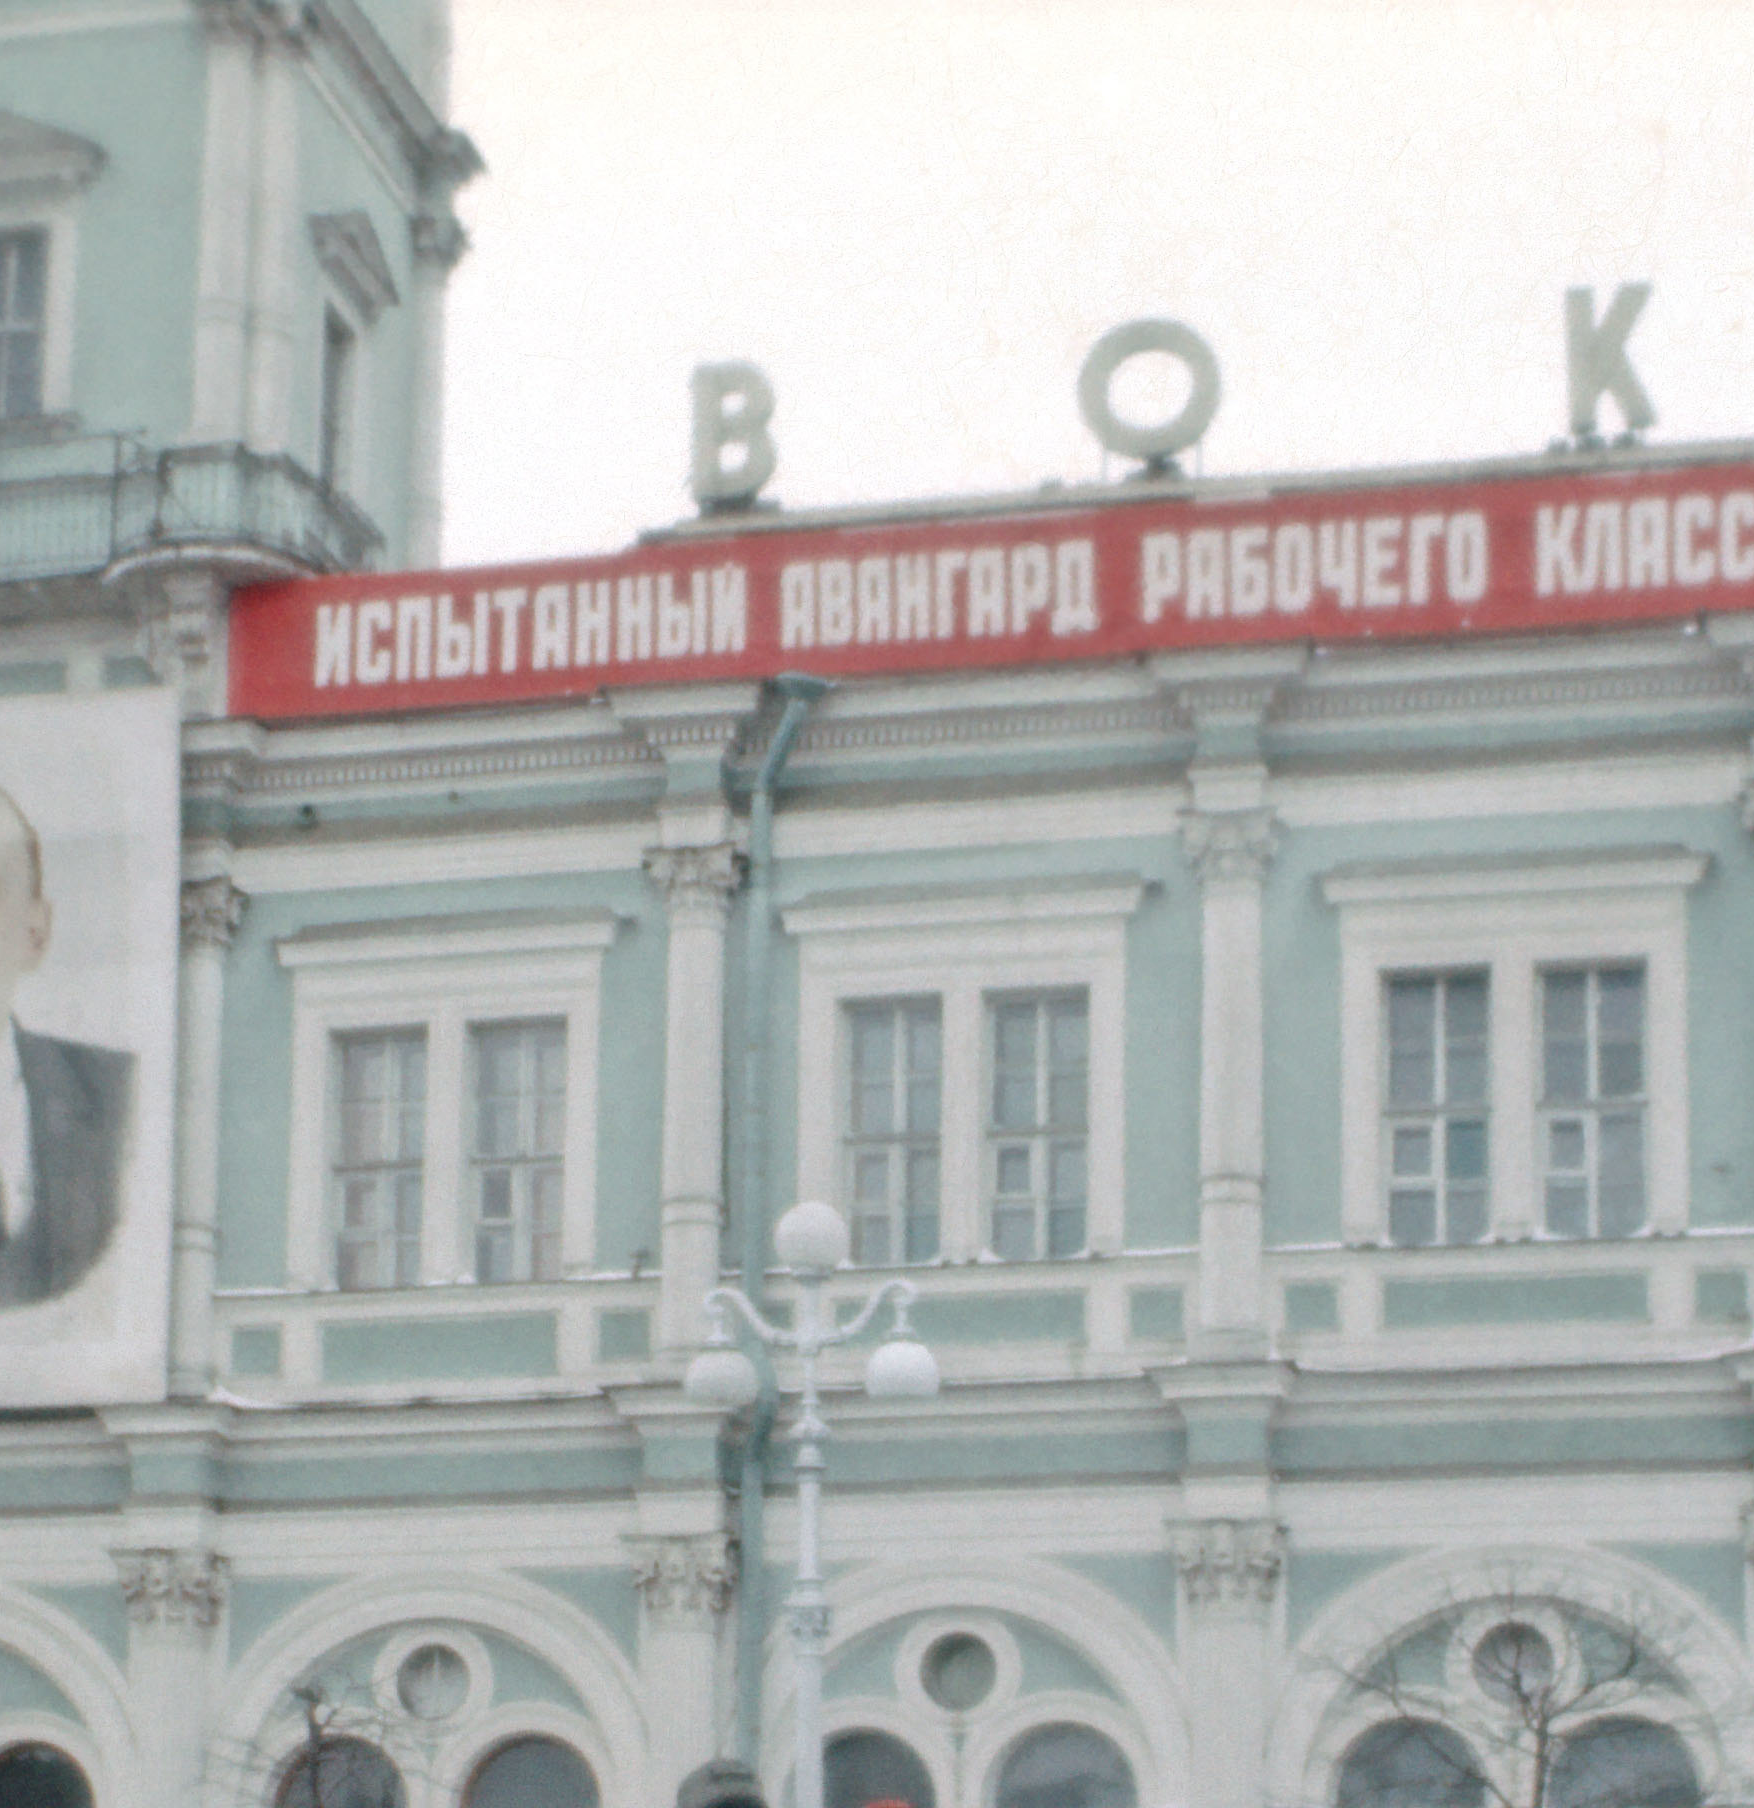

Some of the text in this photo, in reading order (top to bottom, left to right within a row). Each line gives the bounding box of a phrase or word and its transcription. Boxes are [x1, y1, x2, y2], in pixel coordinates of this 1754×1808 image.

[313, 559, 748, 688] ИСПЫТАННЫЙ
[779, 539, 1100, 652] АВАНГАРД
[1142, 510, 1489, 625] РАБОЧЕГО
